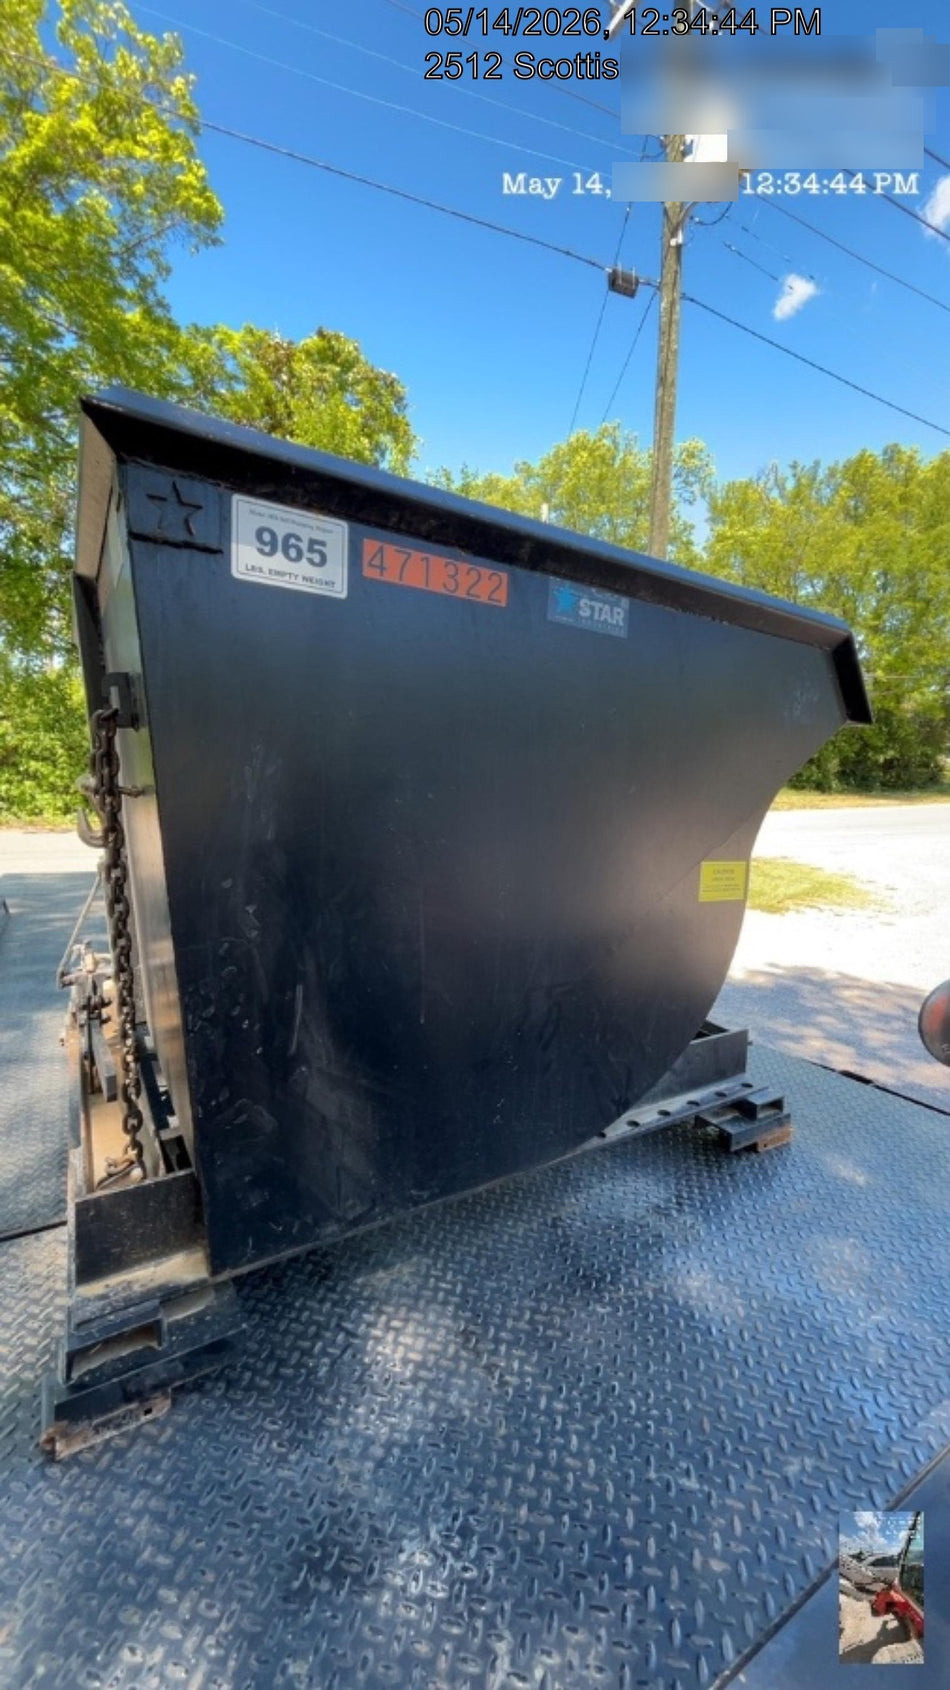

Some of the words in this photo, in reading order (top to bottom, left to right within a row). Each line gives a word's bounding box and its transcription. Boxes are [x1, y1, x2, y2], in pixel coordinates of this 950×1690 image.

[254, 525, 328, 568] 965
[268, 567, 300, 581] EMPTY
[302, 575, 336, 589] WEIGHT
[366, 544, 504, 603] 471322
[578, 598, 625, 626] STAR
